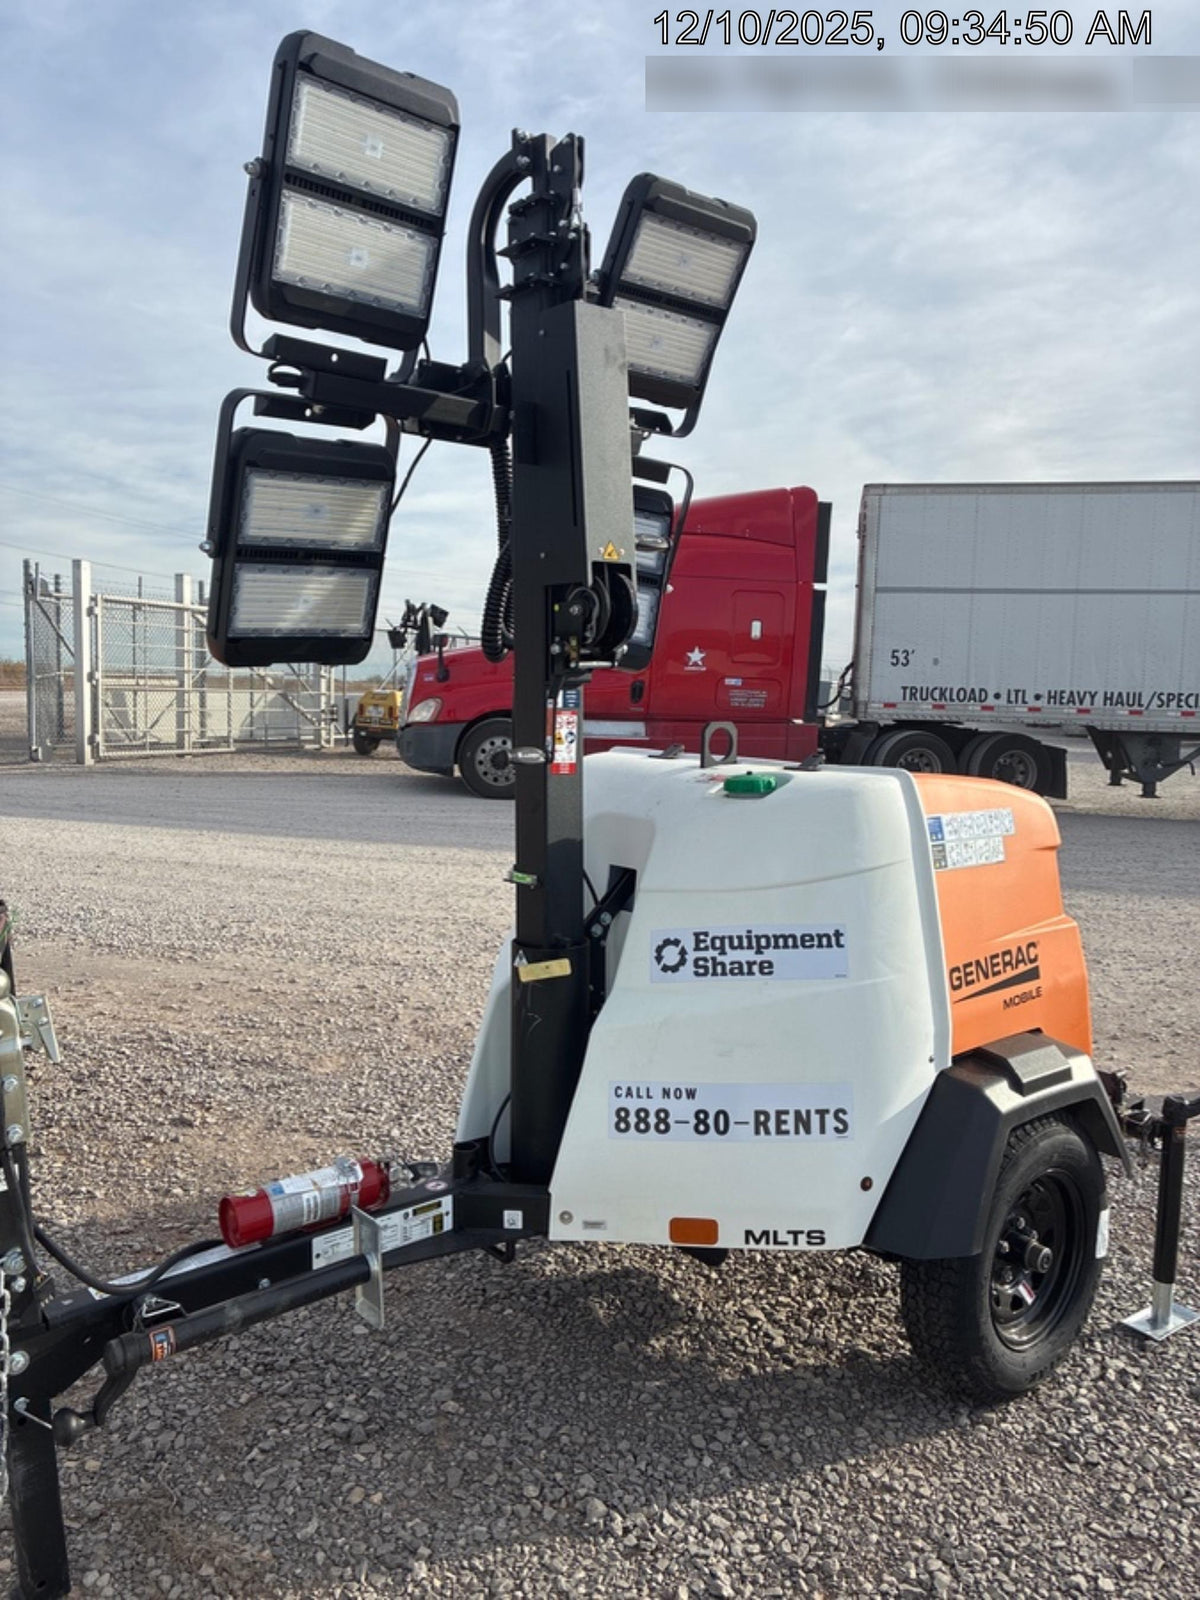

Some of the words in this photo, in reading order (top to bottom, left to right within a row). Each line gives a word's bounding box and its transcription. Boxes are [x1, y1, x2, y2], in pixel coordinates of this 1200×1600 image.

[901, 686, 988, 703] TRUCKLOAD
[1007, 688, 1028, 705] LTL
[1047, 690, 1098, 706] HEAVY
[693, 929, 844, 956] Equipment
[693, 956, 774, 977] Share
[949, 941, 1040, 991] GENERAC
[1002, 986, 1042, 1010] MOBILE
[614, 1086, 653, 1099] CALL
[662, 1087, 697, 1100] NOW
[744, 1229, 826, 1246] MLTS
